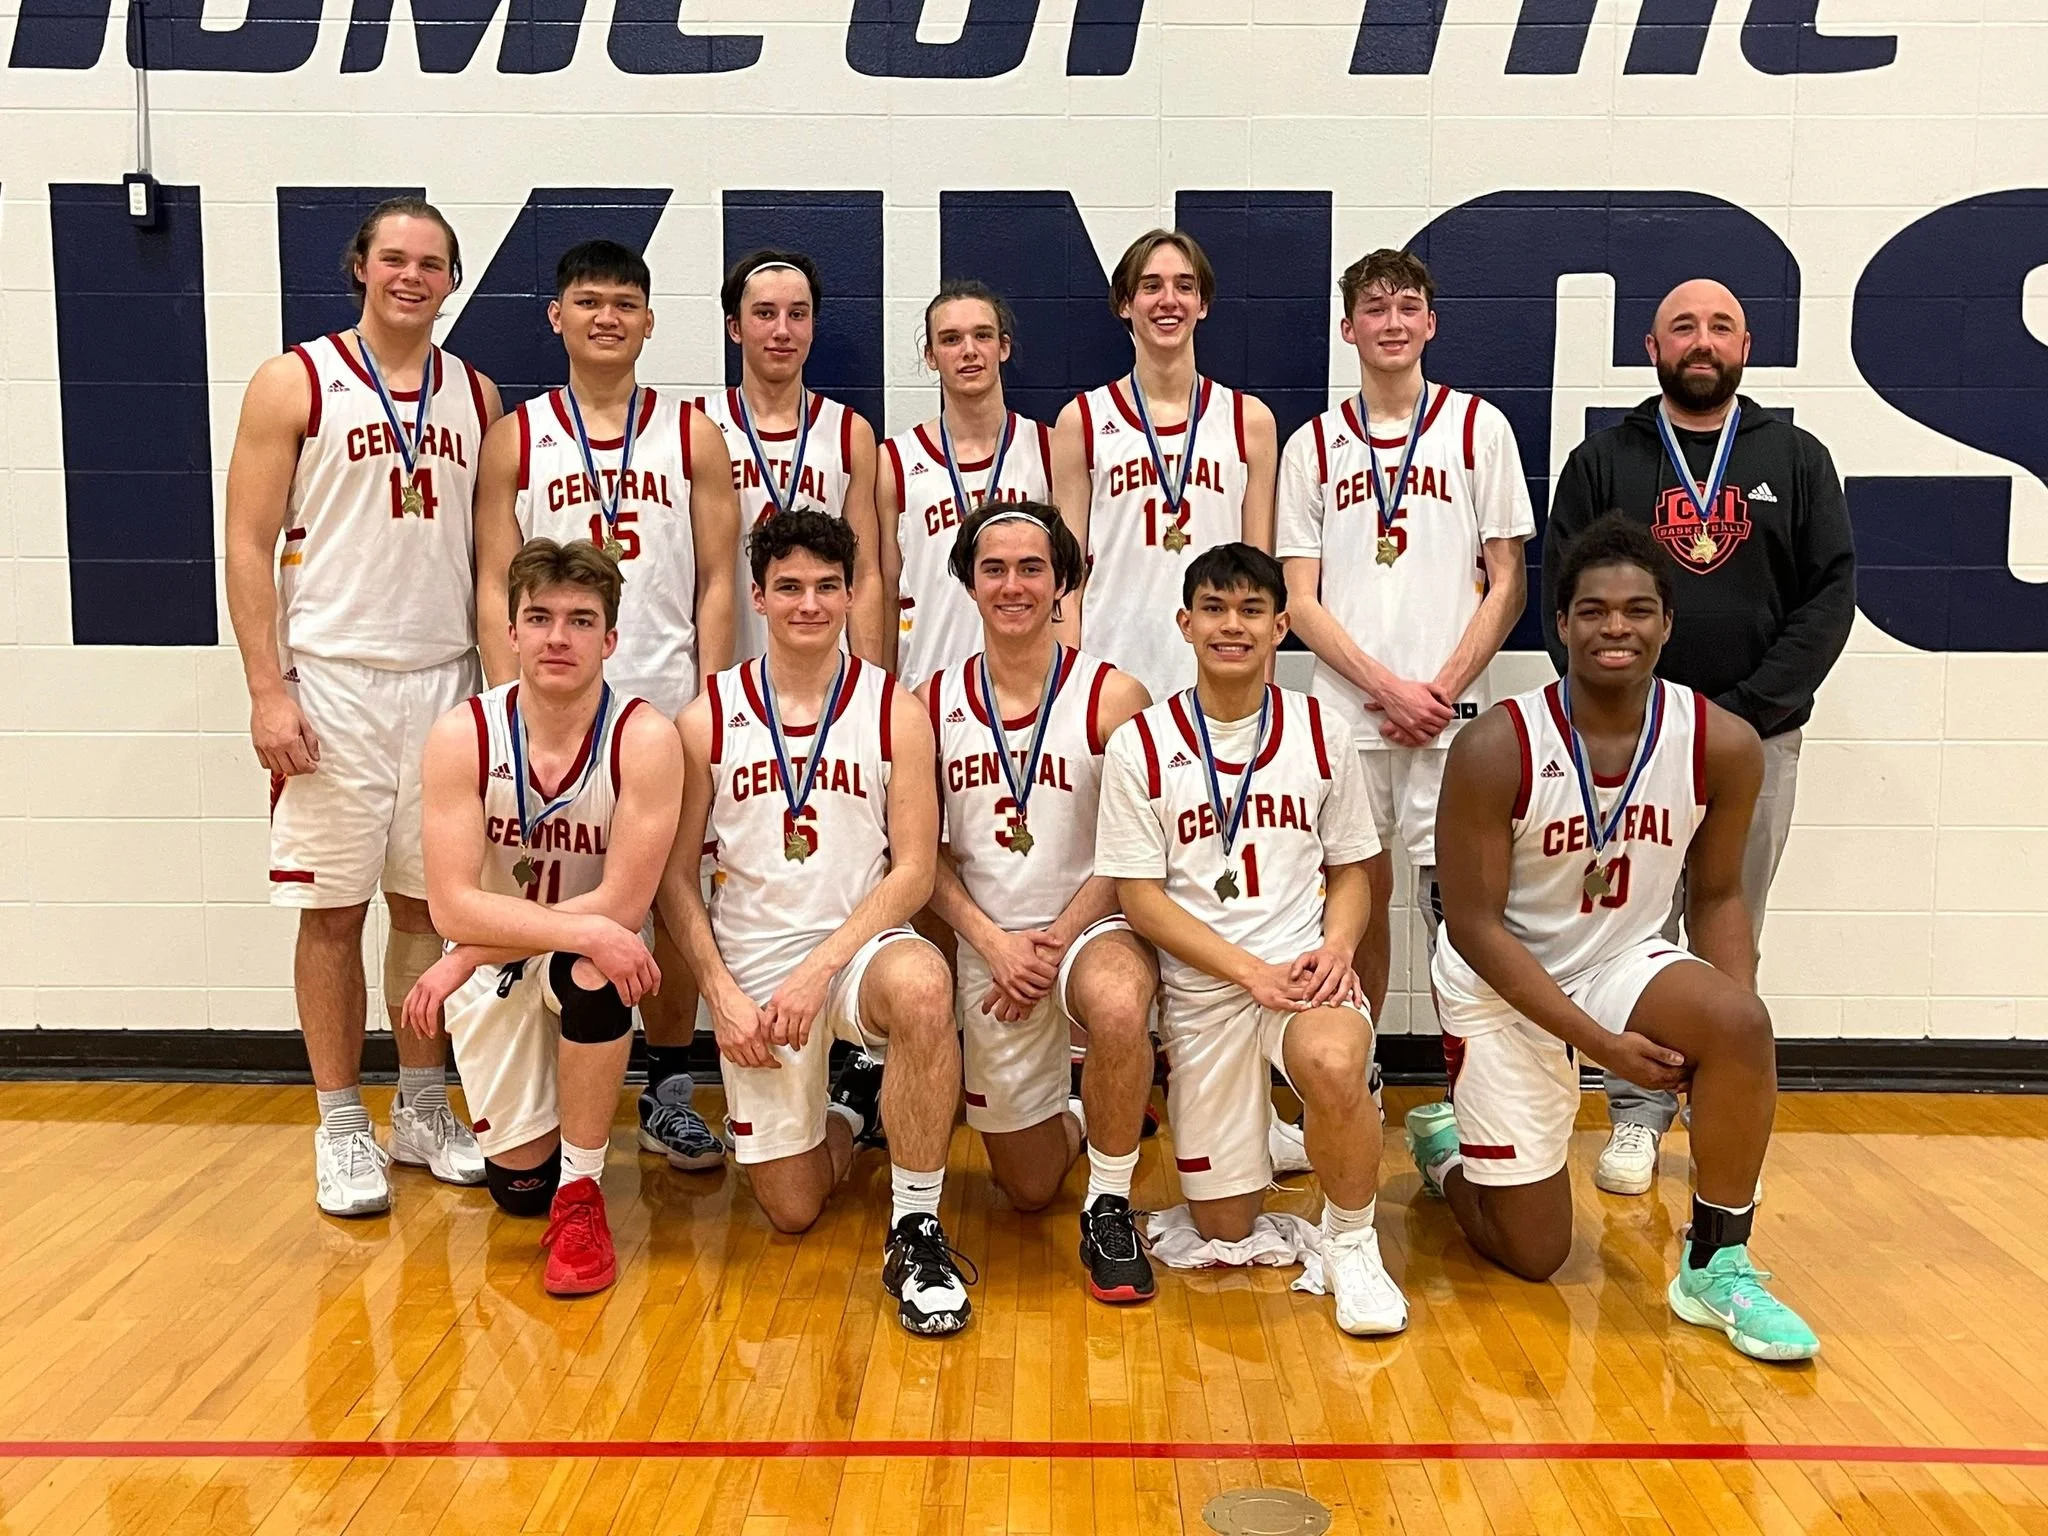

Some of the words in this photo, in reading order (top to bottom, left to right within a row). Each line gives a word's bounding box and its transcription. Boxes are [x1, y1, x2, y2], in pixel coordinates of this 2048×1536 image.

[389, 466, 438, 519] 14
[548, 469, 673, 513] CENTRAL
[1110, 455, 1224, 498] CENAL
[588, 512, 641, 560] 15
[1143, 496, 1191, 546] 12
[1376, 508, 1408, 557] 5
[1660, 522, 1743, 537] BASKEBALL
[732, 757, 867, 802] CENTRAL
[948, 750, 1073, 793] CENAL
[784, 804, 818, 858] 6
[993, 797, 1032, 848] 3
[525, 860, 561, 904] 11
[1241, 843, 1260, 898] 1
